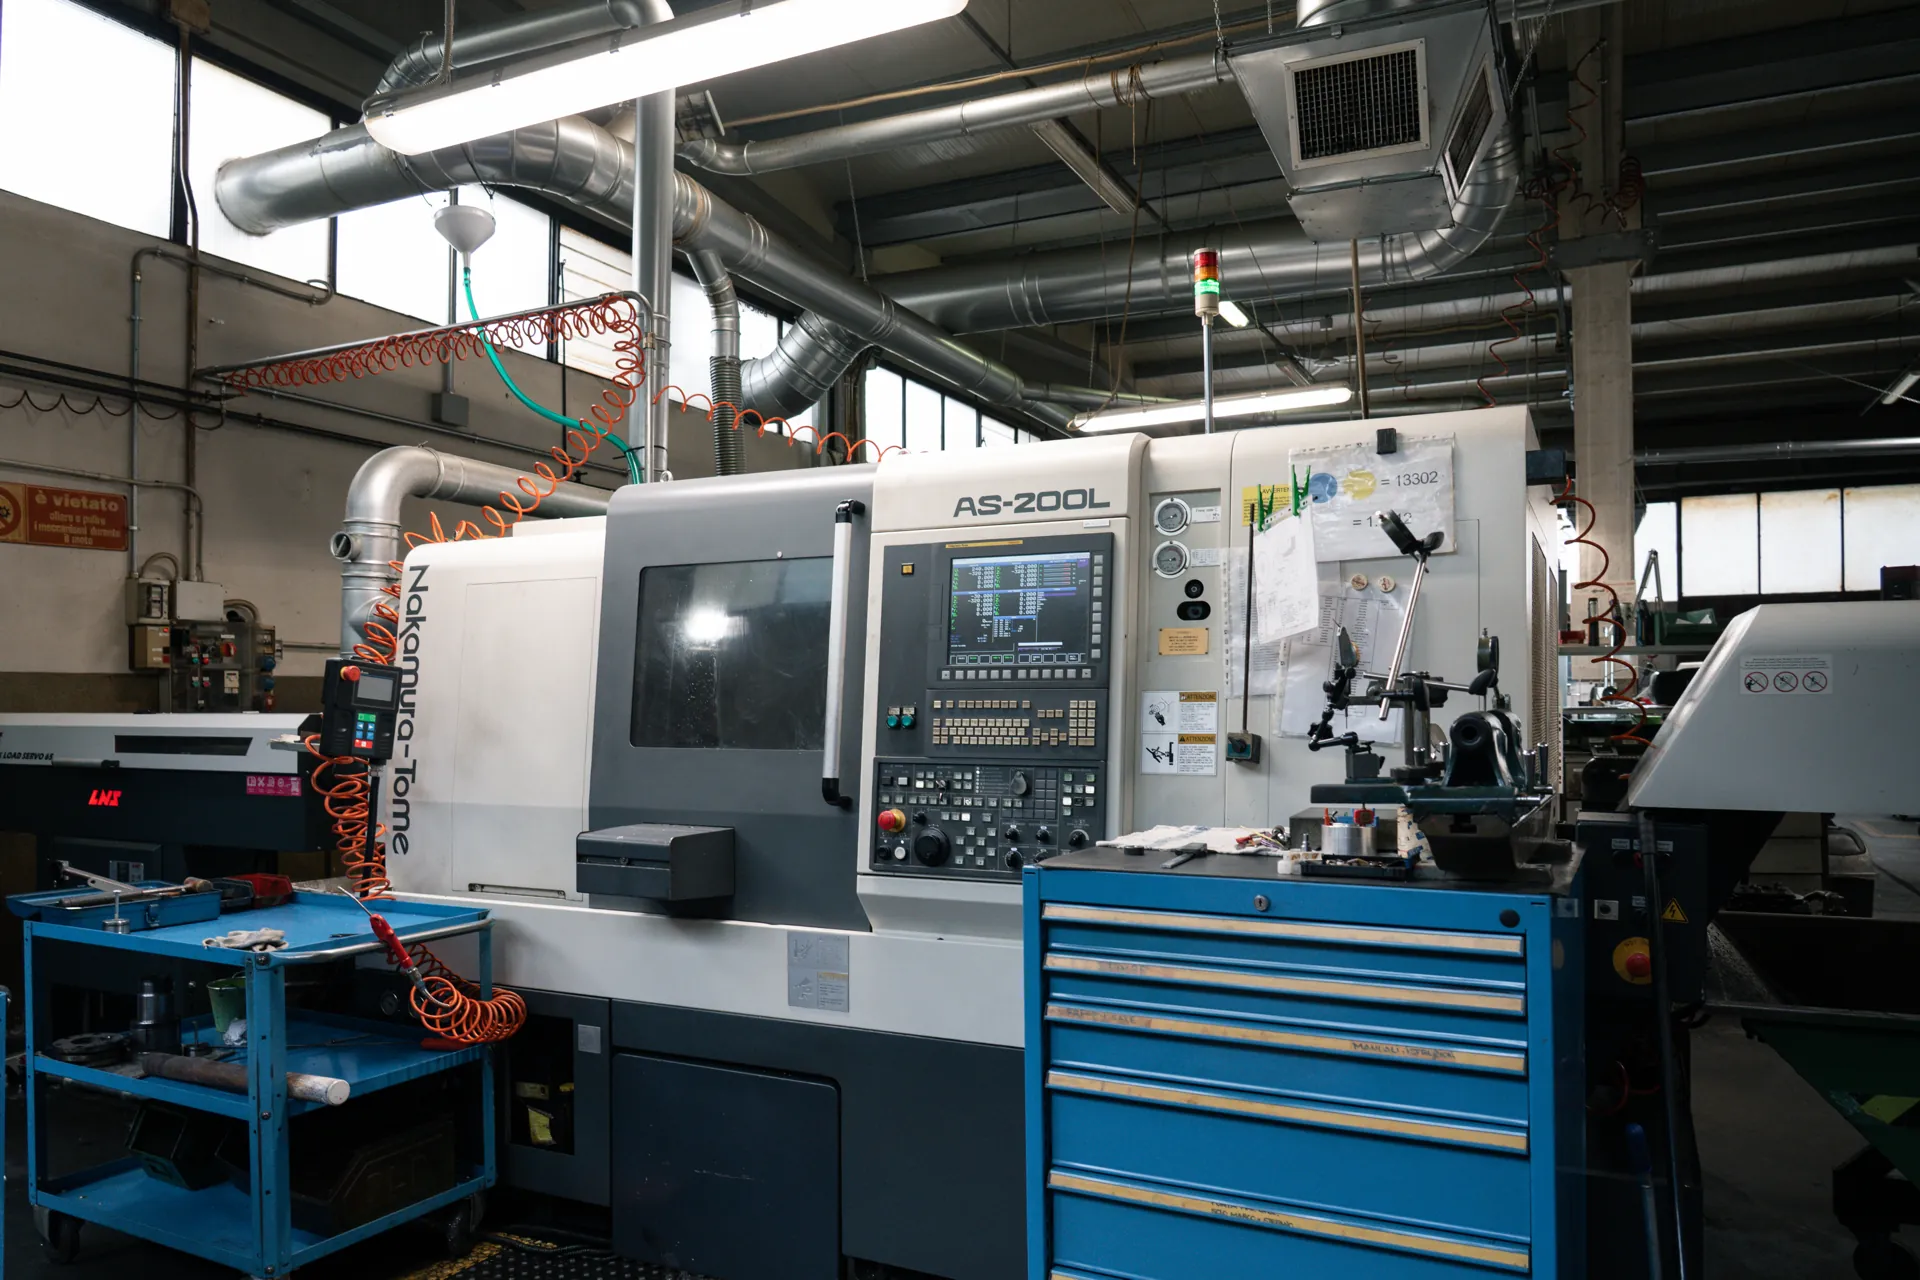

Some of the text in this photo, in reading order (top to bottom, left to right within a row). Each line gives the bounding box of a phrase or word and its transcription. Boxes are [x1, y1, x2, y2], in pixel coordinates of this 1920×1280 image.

[1395, 471, 1439, 487] 13302
[35, 490, 119, 513] è vietato
[953, 488, 1110, 518] AS-200L
[392, 564, 430, 856] Nakamura-Tome
[3, 751, 22, 759] LOAD
[22, 752, 44, 760] SERVO
